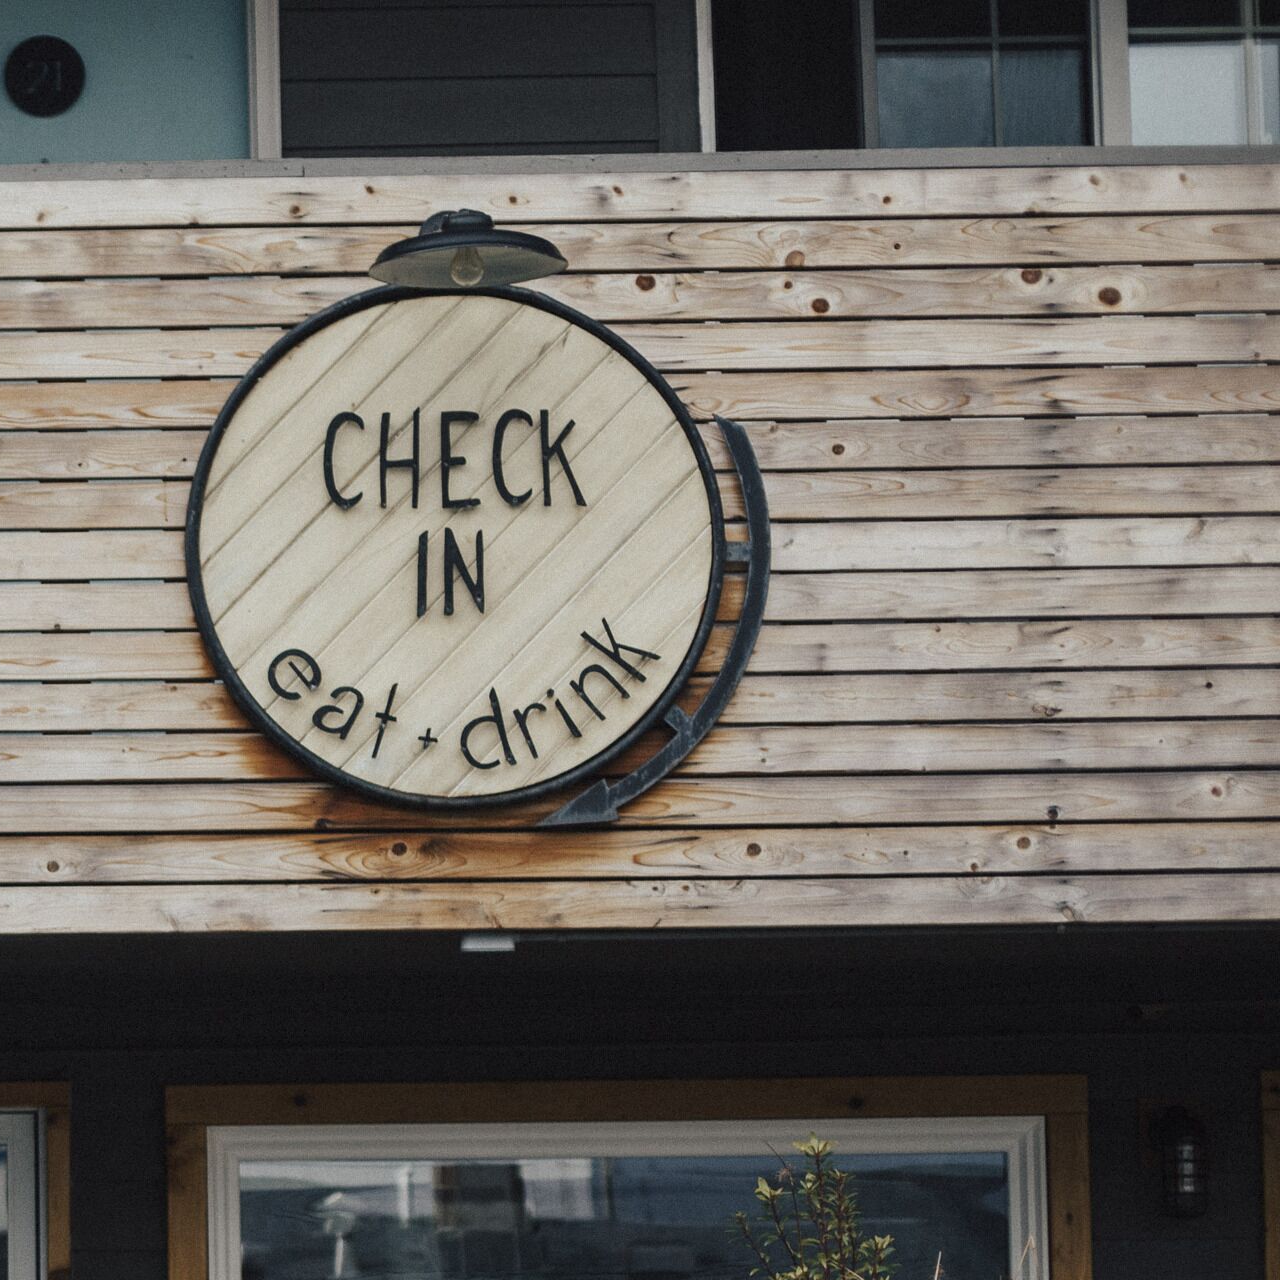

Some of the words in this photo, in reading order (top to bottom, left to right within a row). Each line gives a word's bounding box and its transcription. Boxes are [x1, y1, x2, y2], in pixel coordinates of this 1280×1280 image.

[323, 407, 587, 511] CHECK
[416, 526, 485, 618] IN
[267, 648, 399, 758] eat
[417, 727, 439, 750] +
[459, 617, 661, 770] drink
